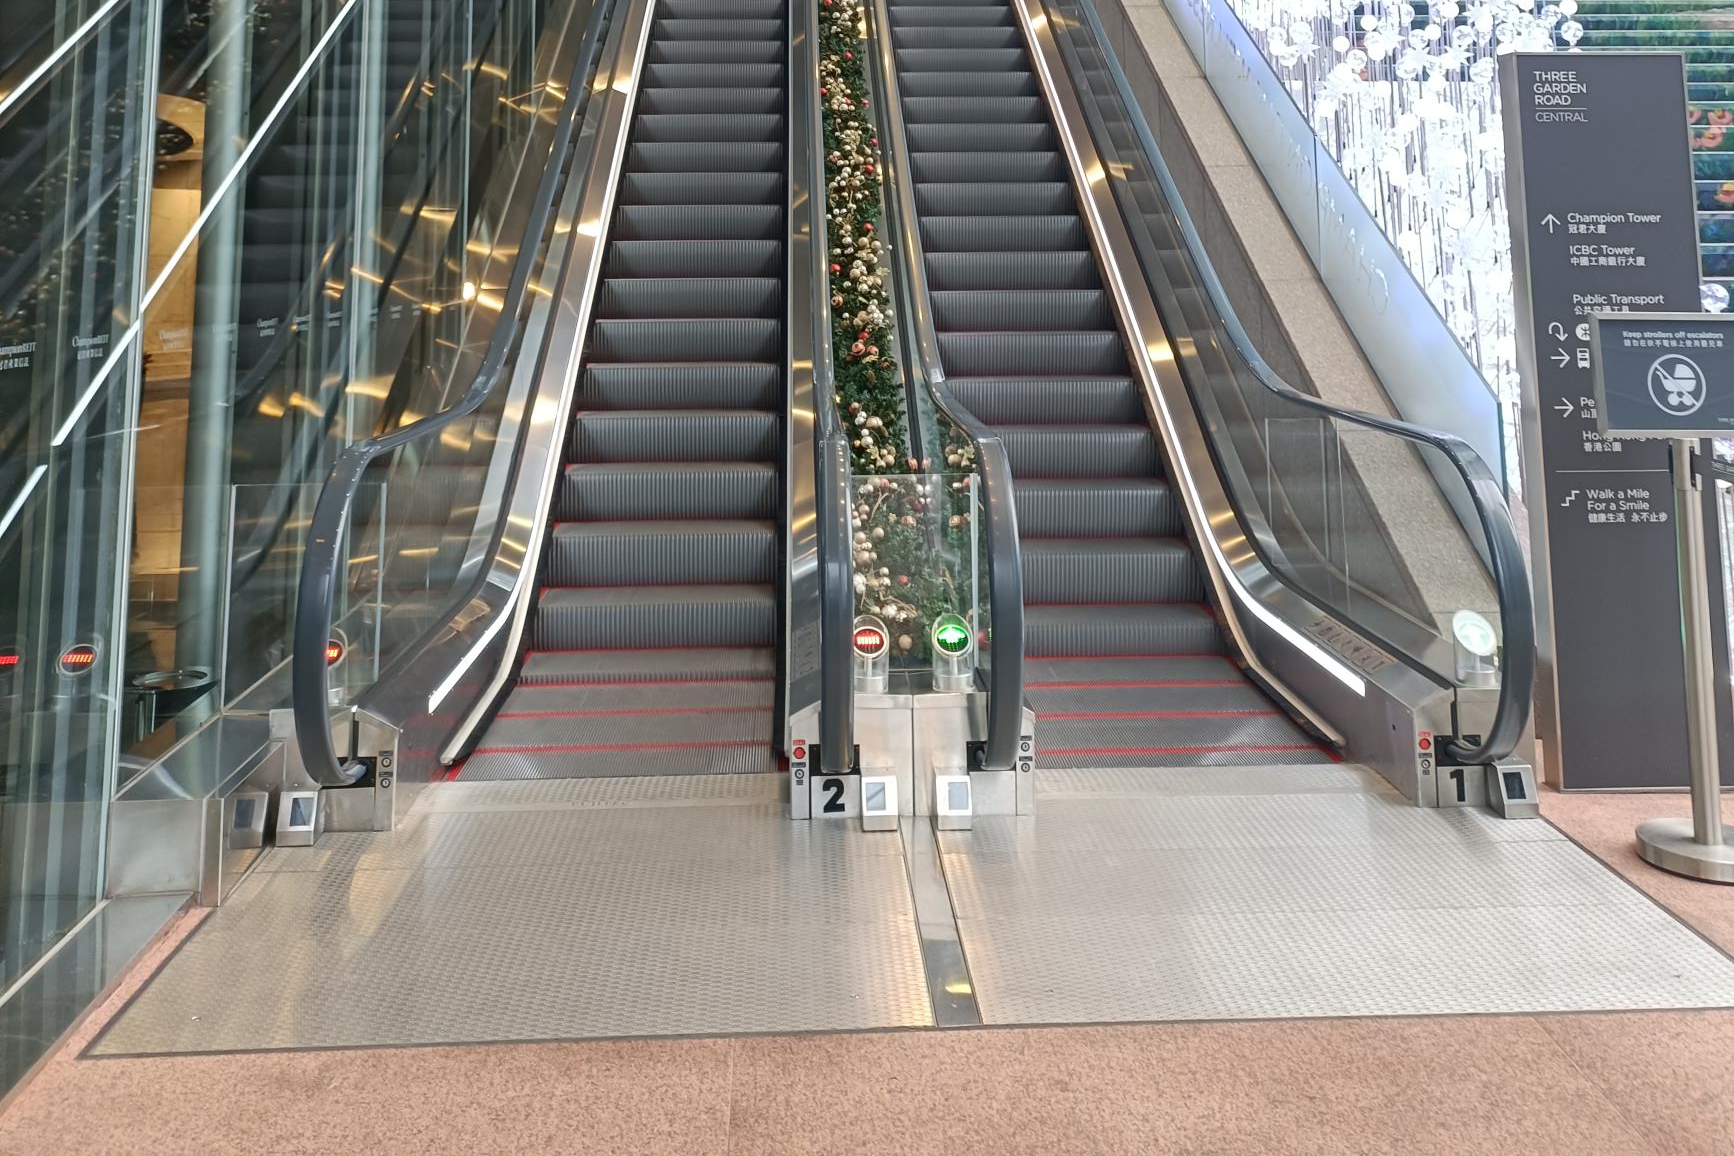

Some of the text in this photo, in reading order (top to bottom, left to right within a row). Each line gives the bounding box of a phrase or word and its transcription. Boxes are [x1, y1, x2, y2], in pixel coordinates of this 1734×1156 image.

[1533, 71, 1577, 82] THREE
[1533, 83, 1587, 94] GARDEN
[1535, 95, 1571, 106] ROAD
[1535, 112, 1588, 122] CENTRAL
[1567, 212, 1661, 225] Champion Tower
[1569, 245, 1635, 255] ICBC Tower
[1573, 294, 1664, 306] Public Transport
[1622, 330, 1642, 339] Keep
[1674, 330, 1686, 339] off
[1687, 331, 1724, 339] escalators
[1586, 489, 1650, 499] Walk a Mile
[1587, 501, 1650, 511] For a Smile
[1450, 769, 1465, 802] 1
[823, 778, 846, 813] 2
